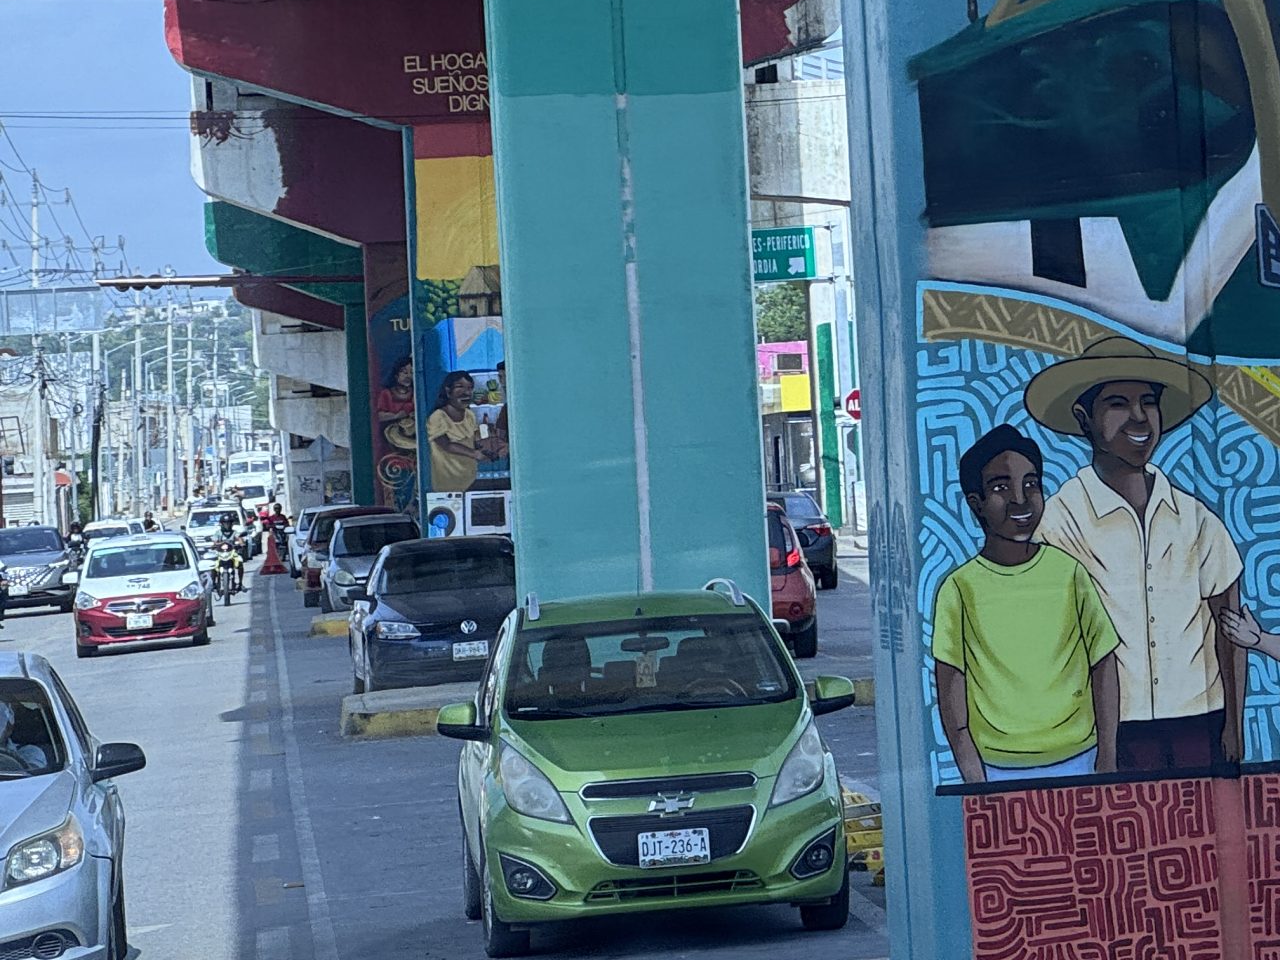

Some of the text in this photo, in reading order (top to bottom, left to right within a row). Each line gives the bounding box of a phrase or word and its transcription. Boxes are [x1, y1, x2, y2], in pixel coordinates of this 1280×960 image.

[404, 55, 427, 73] EL
[413, 70, 489, 95] SUEÑOS
[642, 837, 707, 857] DJT-236-A
